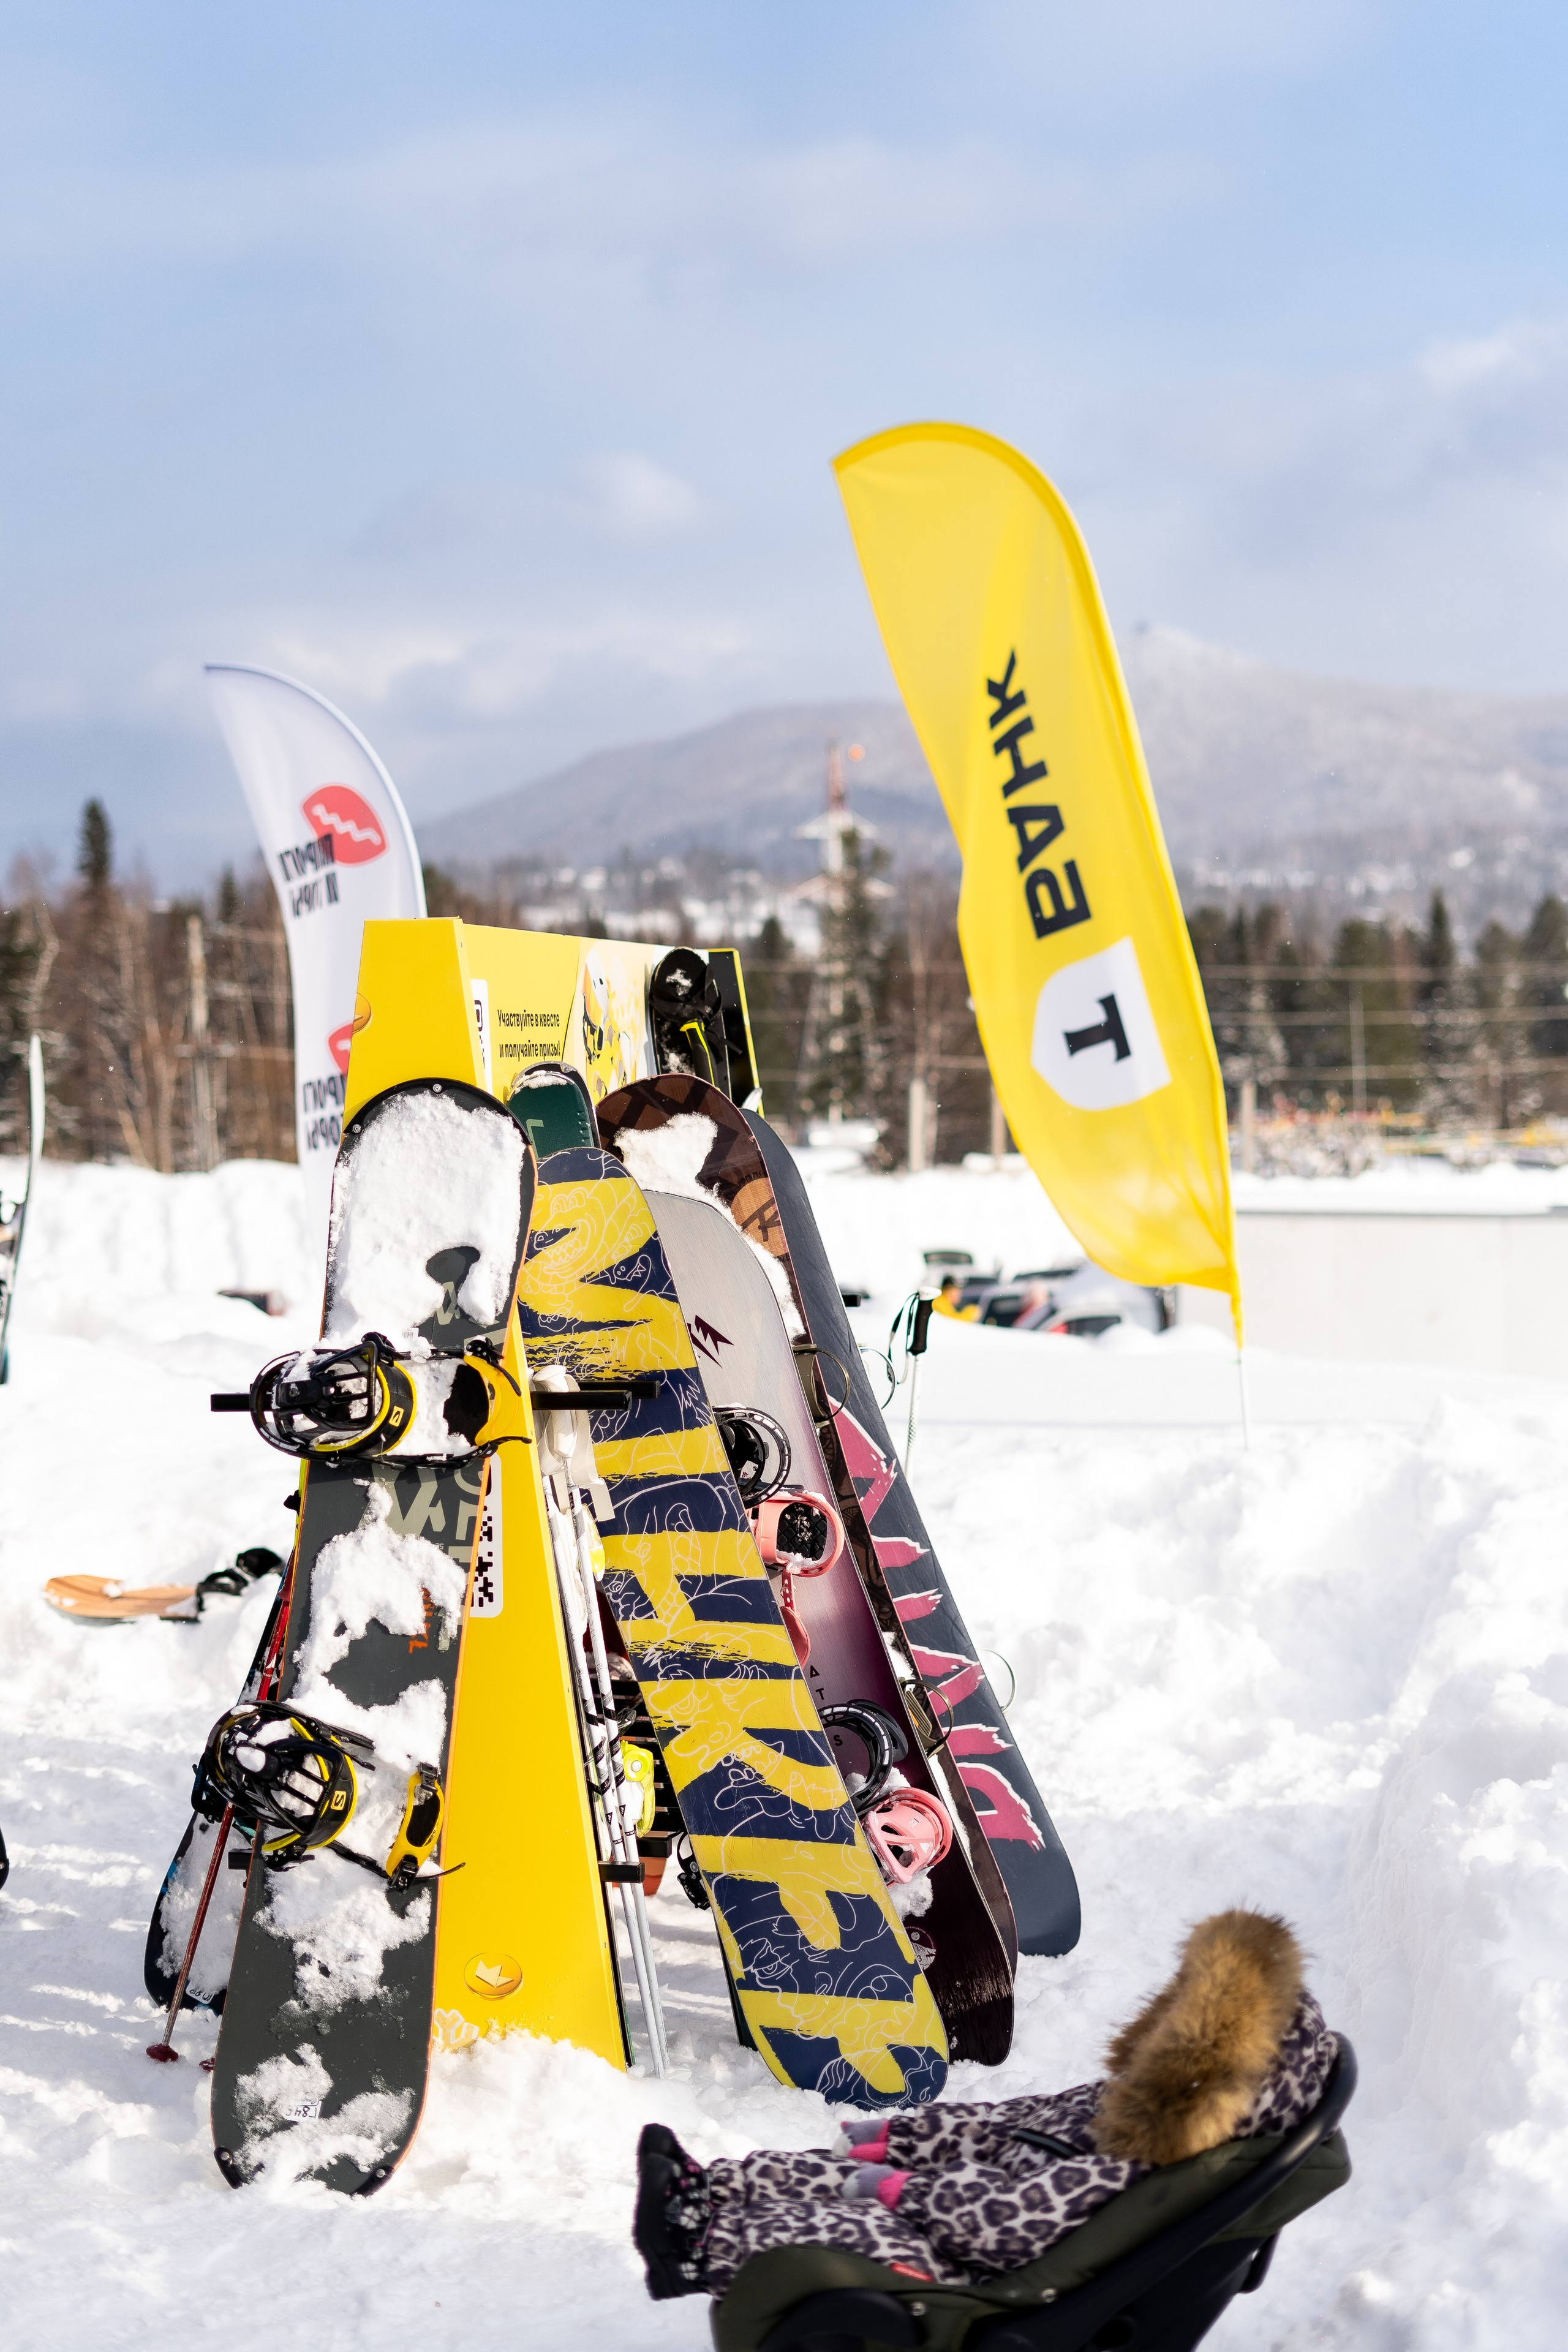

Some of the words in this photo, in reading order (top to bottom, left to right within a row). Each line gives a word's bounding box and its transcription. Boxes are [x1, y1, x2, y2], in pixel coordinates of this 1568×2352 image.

[497, 1009, 534, 1031] Участвуйте
[535, 1014, 539, 1027] в
[540, 1014, 560, 1027] квесте
[499, 1044, 504, 1058] и
[505, 1039, 538, 1062] получайте
[539, 1040, 560, 1061] призы!
